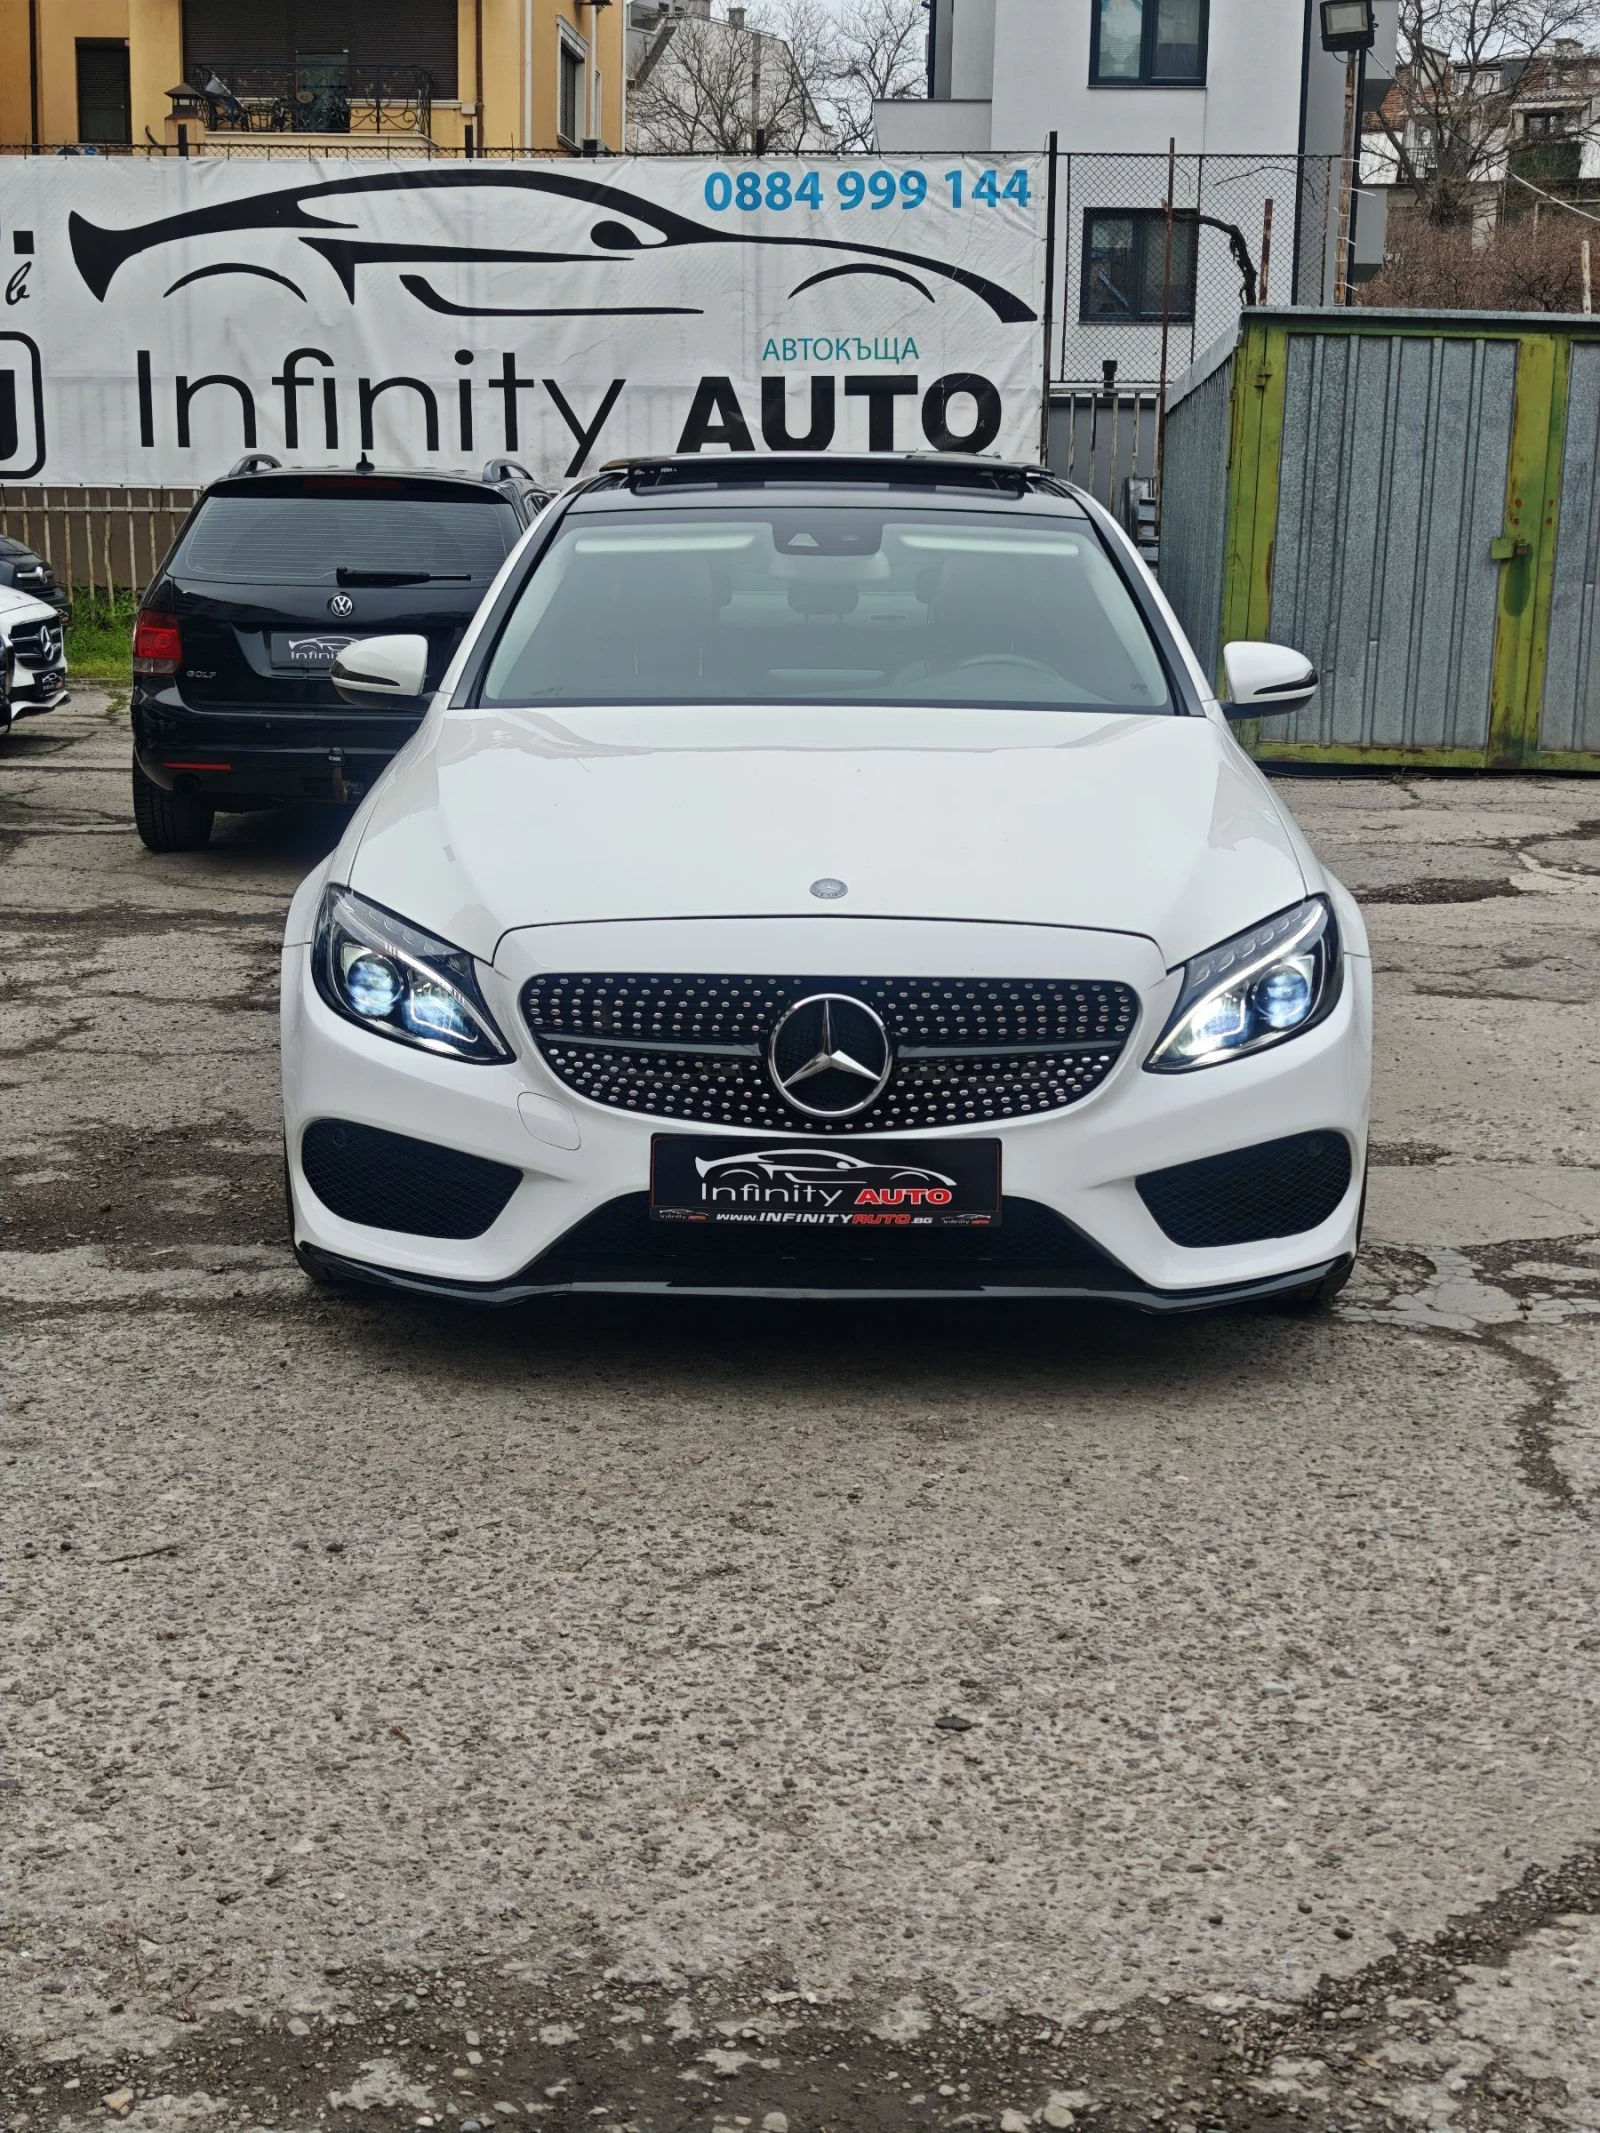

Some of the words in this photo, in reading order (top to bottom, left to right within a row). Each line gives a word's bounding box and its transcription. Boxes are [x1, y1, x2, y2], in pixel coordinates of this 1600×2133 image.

[705, 172, 823, 211] 0884
[837, 171, 927, 210] 999
[945, 170, 1031, 208] 144
[763, 337, 919, 363] АВТОКЪЩА
[138, 348, 626, 478] Infinity
[677, 373, 1002, 454] AUTO
[290, 650, 341, 660] Infinit
[186, 670, 217, 678] GOLF
[701, 1182, 843, 1207] Infinity
[854, 1188, 953, 1205] AUTO
